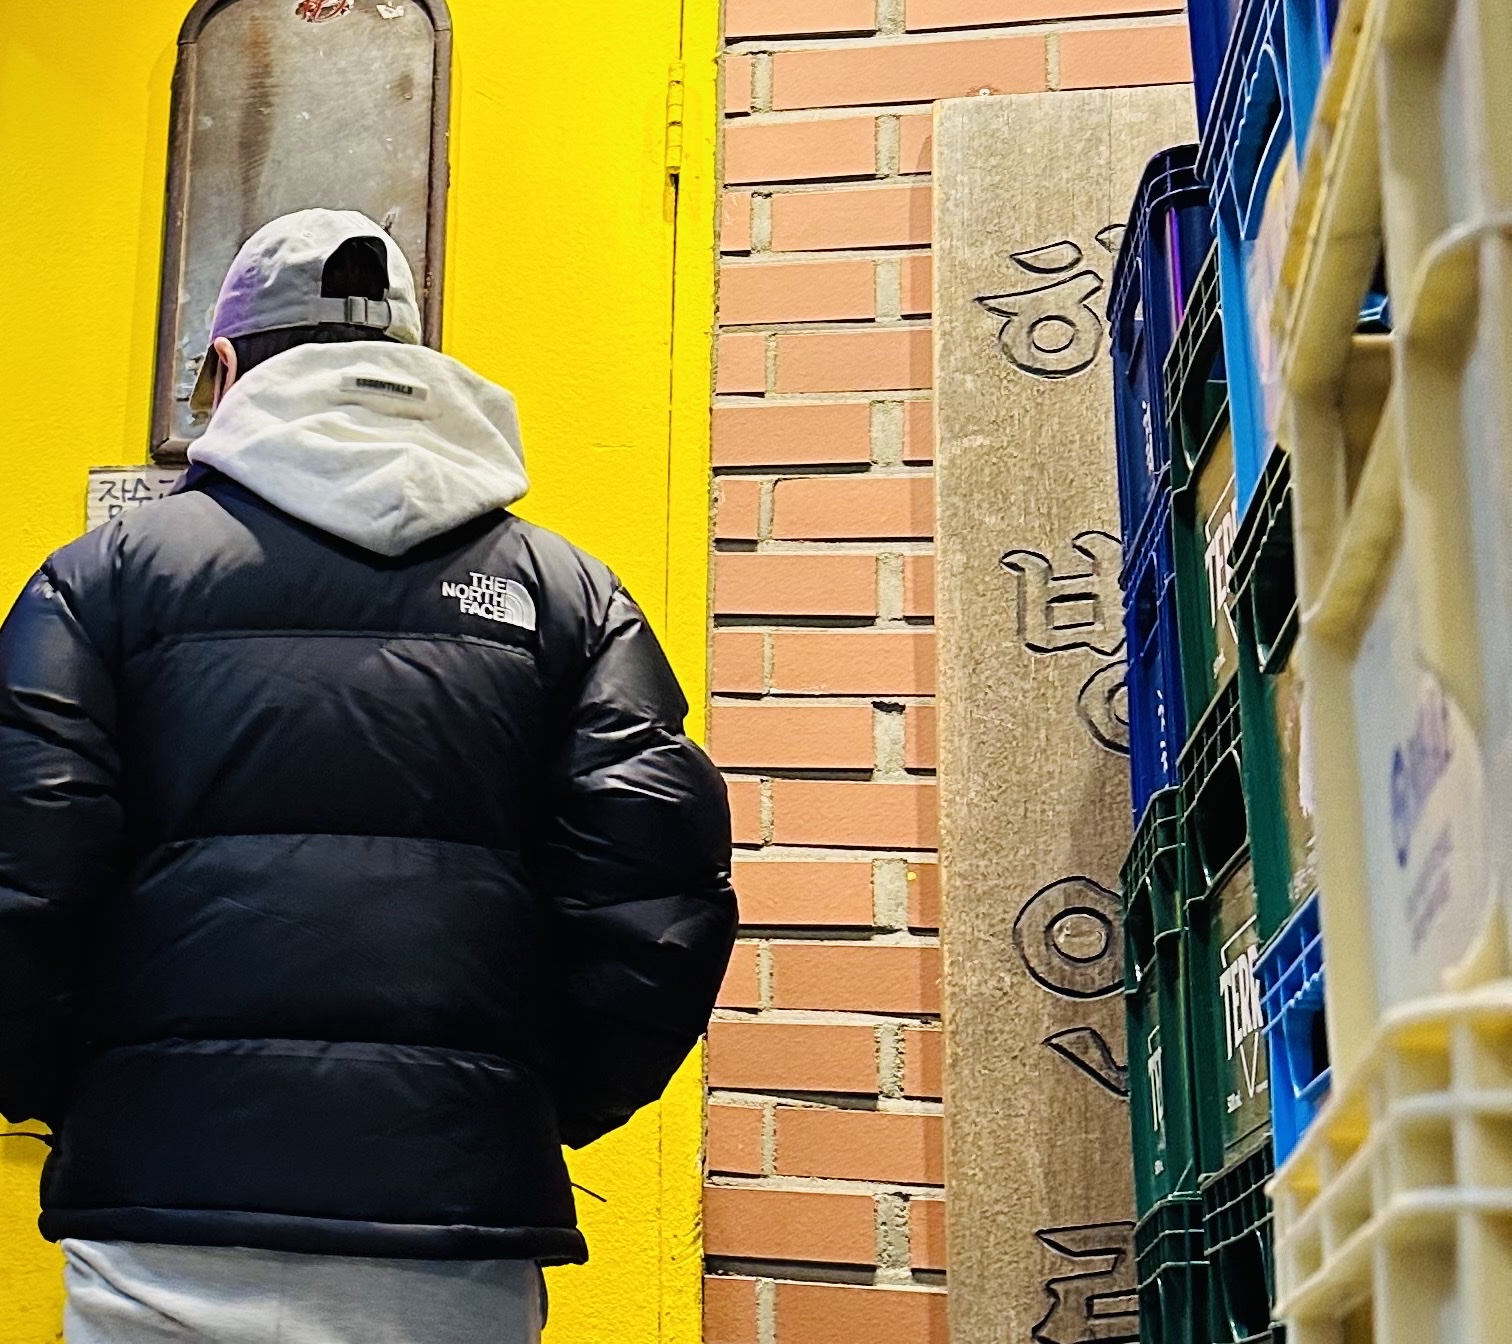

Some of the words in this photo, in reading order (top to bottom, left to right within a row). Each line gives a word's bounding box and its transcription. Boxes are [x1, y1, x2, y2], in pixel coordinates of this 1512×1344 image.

[355, 377, 414, 395] ESSENTIALS
[469, 571, 508, 593] THE
[441, 581, 506, 608] NORTH
[459, 599, 506, 623] FACE
